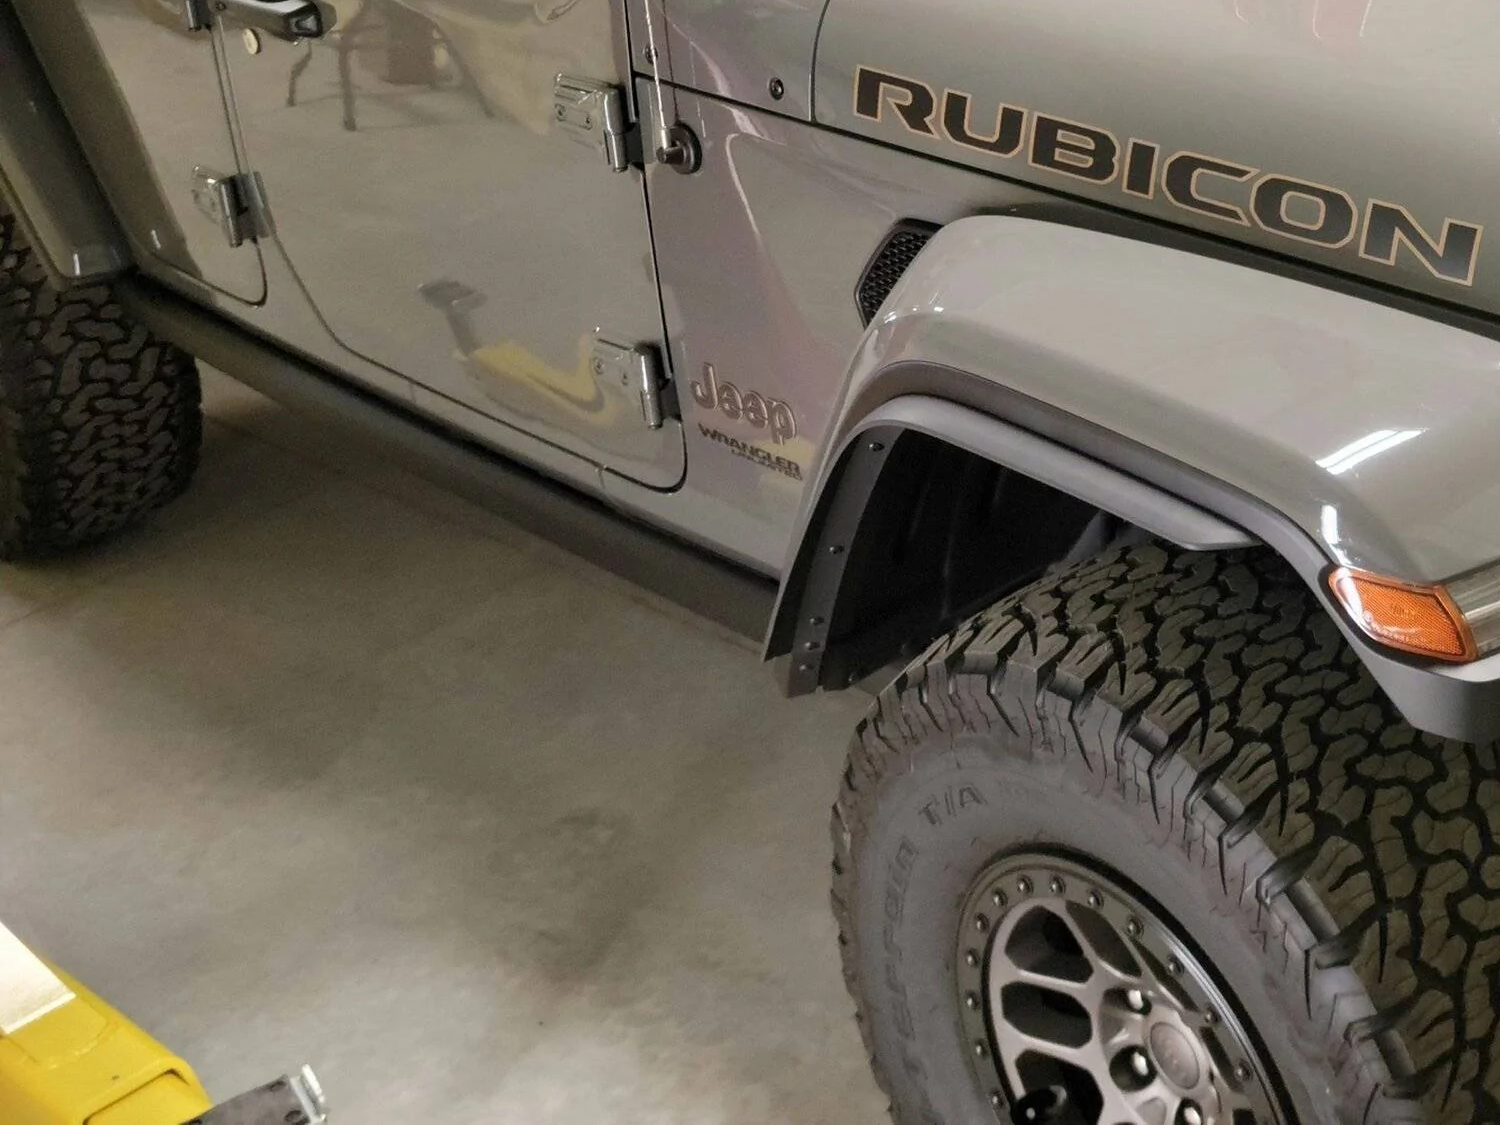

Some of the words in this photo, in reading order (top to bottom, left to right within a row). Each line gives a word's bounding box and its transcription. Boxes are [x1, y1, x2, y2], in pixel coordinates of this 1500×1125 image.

[854, 65, 1484, 286] RUBICON
[690, 362, 797, 446] Jeep
[698, 422, 801, 474] WRANGLER
[918, 785, 987, 826] T/A
